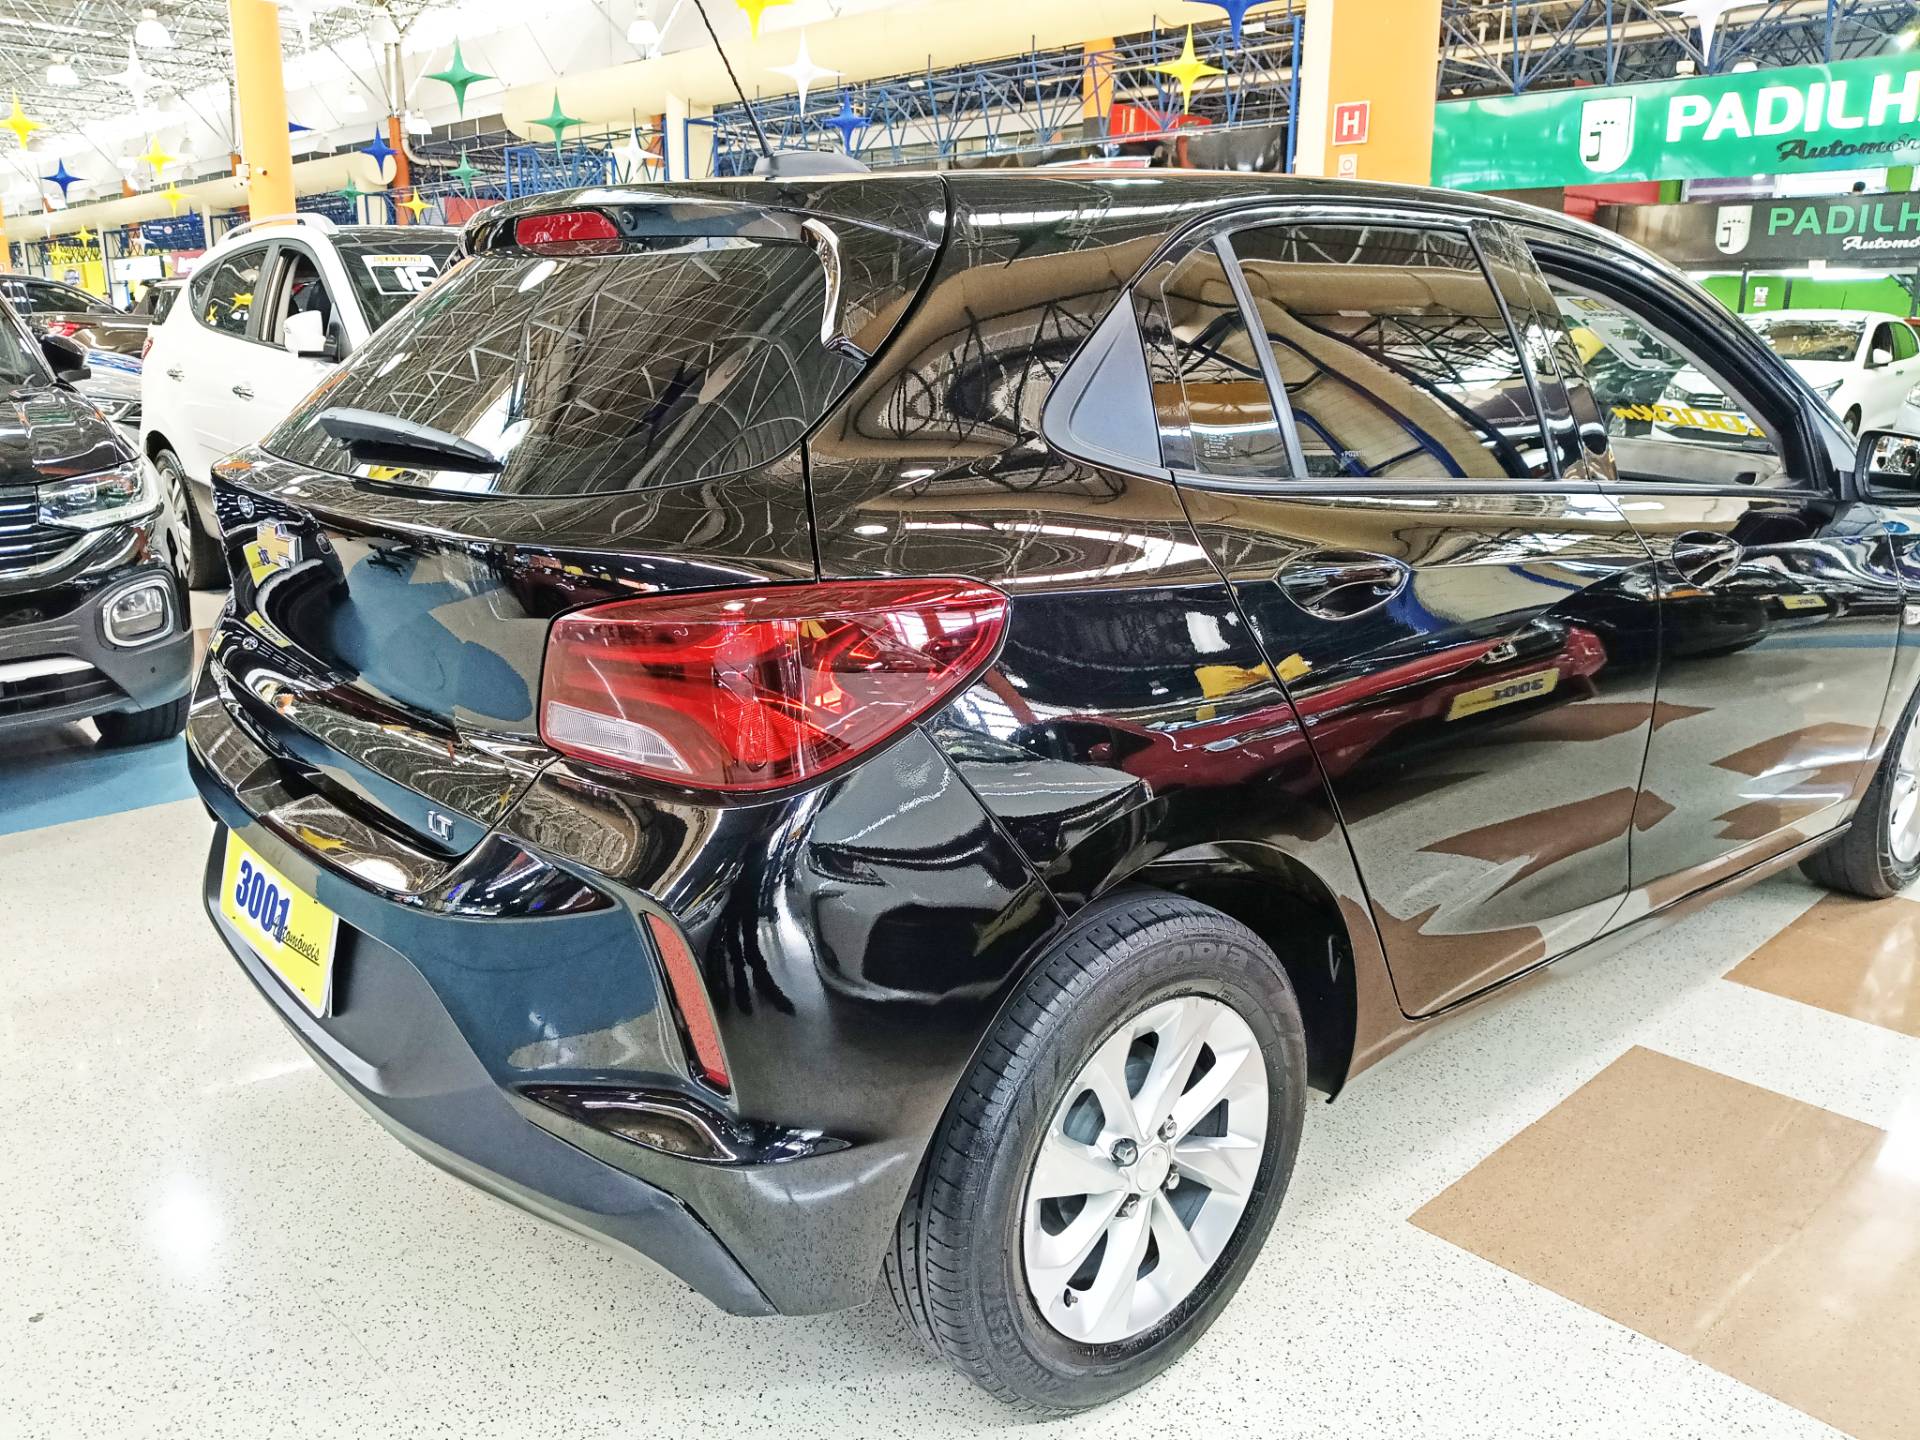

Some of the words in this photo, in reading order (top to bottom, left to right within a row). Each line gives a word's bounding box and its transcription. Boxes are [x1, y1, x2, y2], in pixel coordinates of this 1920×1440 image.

[1342, 110, 1360, 136] H
[1666, 70, 1920, 143] PADILH
[428, 810, 454, 840] LT
[235, 860, 291, 943] 3001
